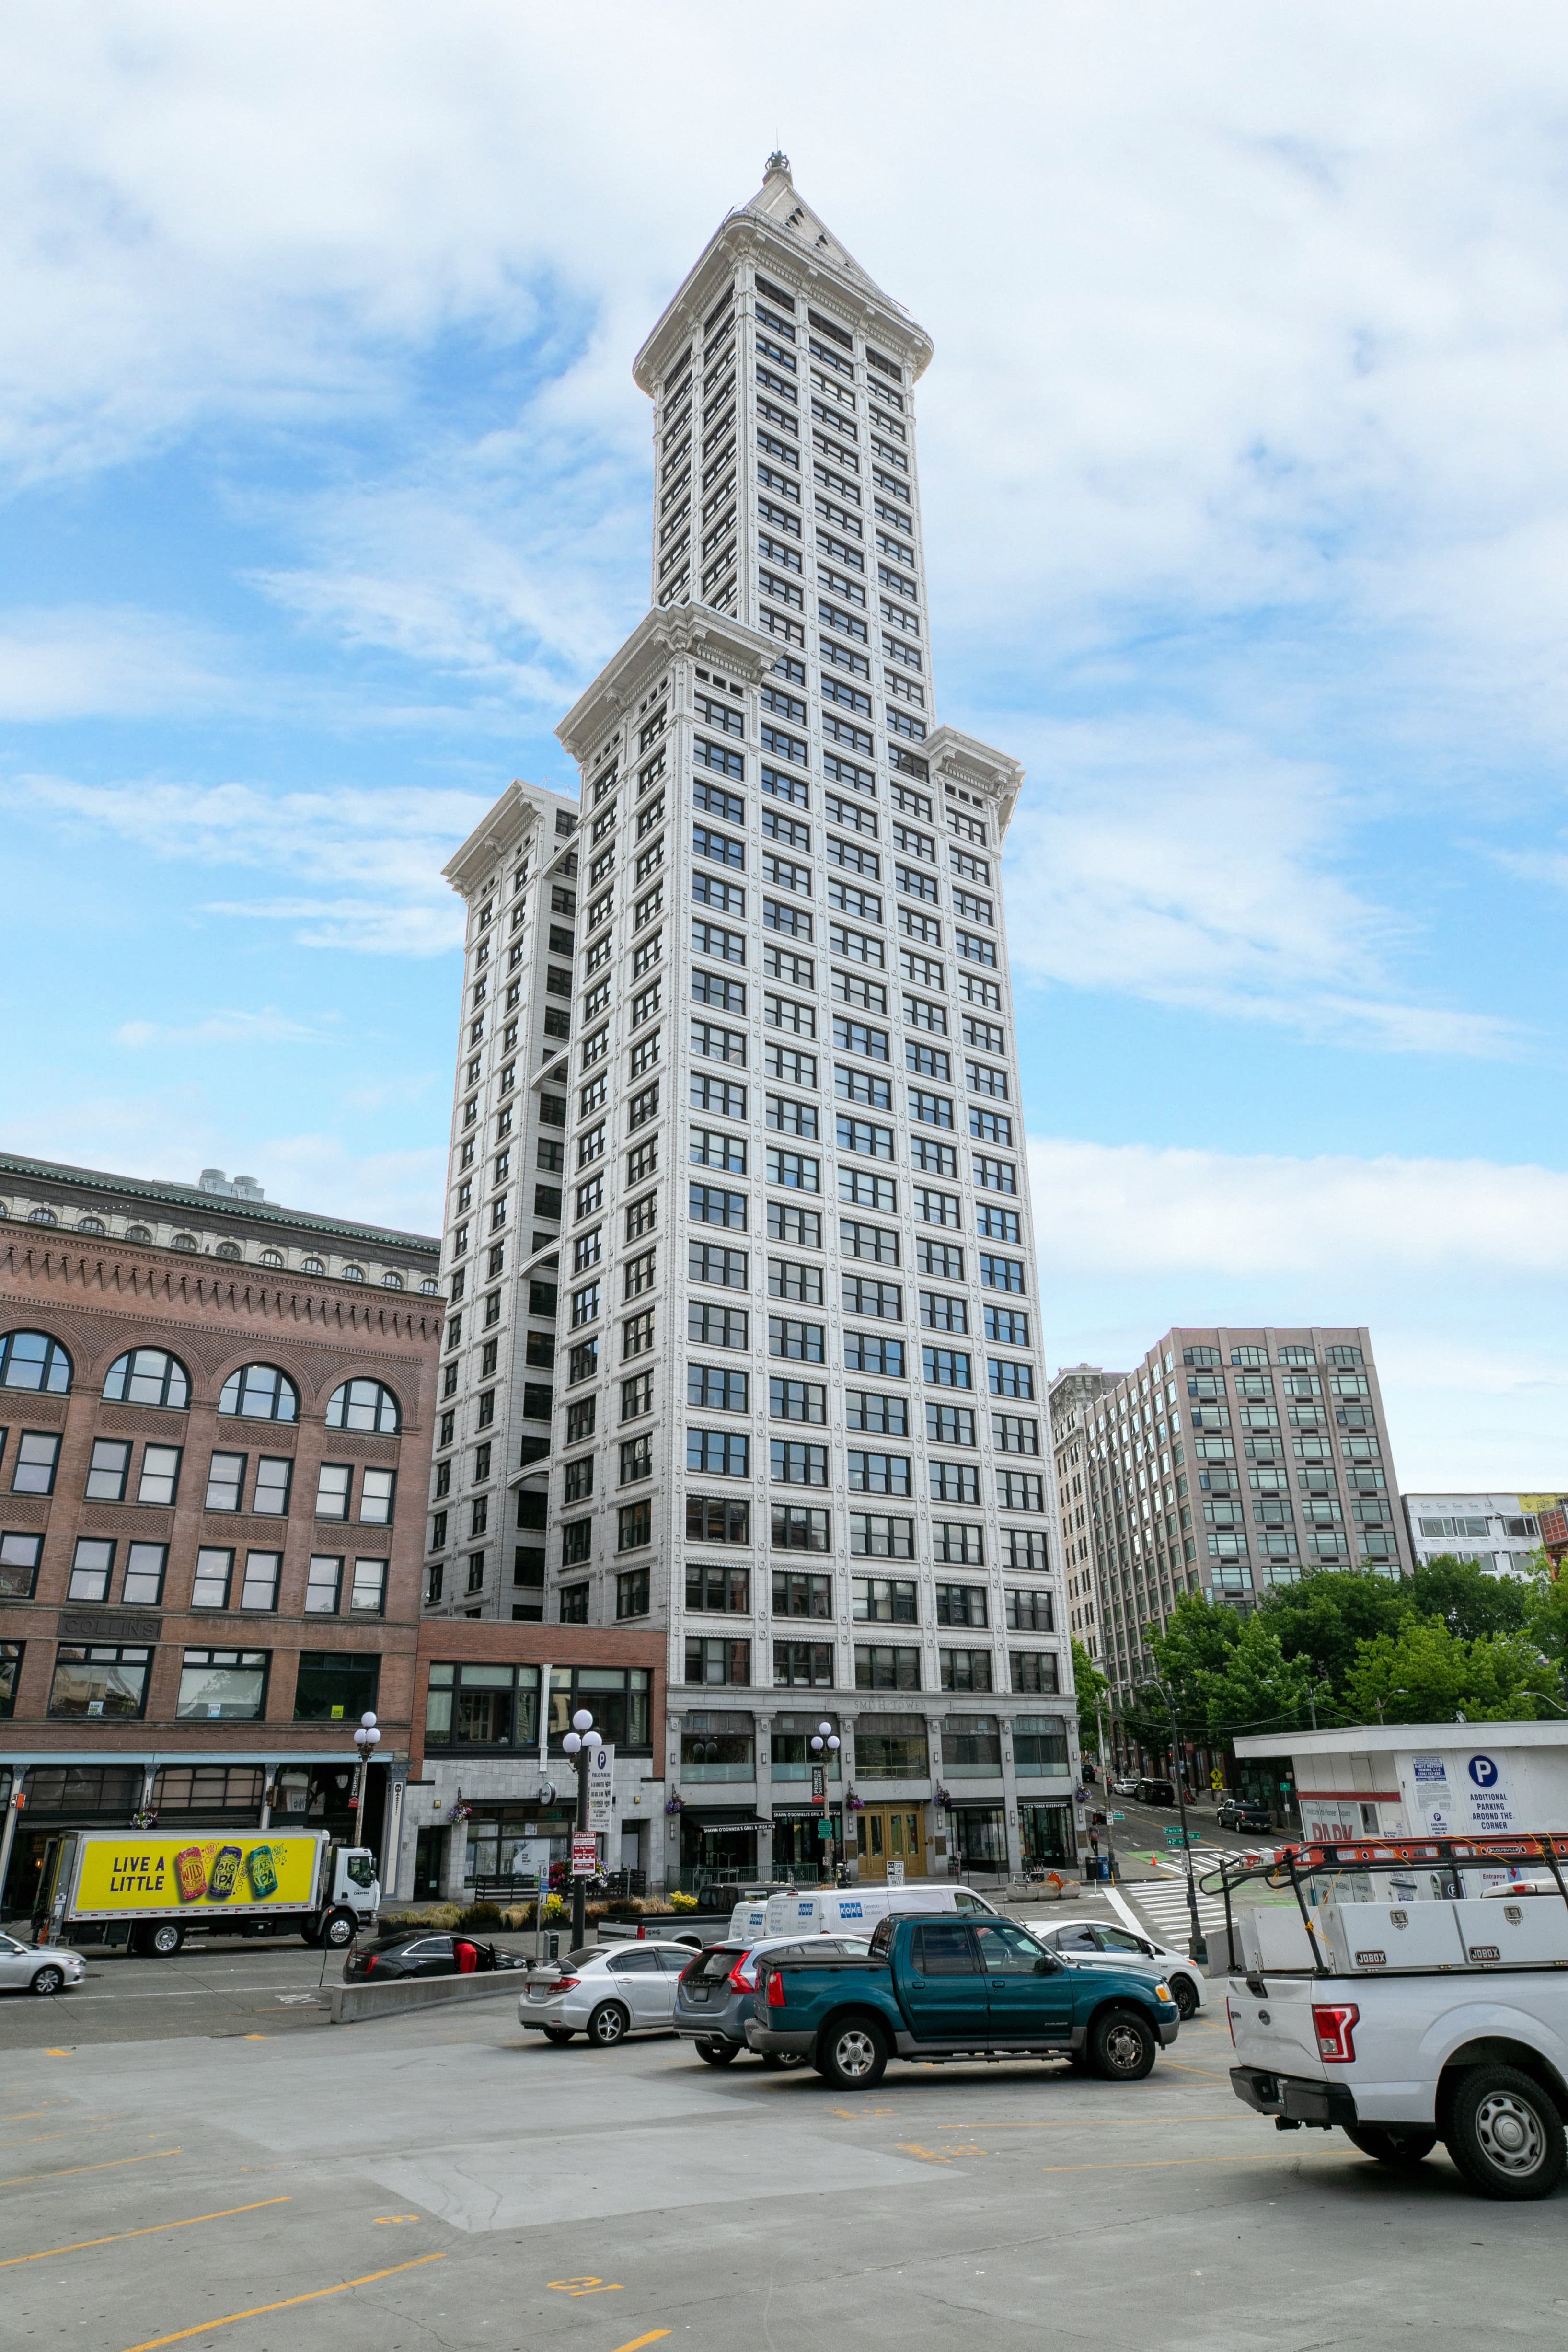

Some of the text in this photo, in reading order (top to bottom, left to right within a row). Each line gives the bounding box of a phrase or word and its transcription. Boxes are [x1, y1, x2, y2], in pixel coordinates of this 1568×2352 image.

[65, 1620, 155, 1637] COLLINS
[854, 1700, 926, 1710] SMITH TOWER
[113, 1856, 165, 1872] LIVE A
[218, 1863, 235, 1871] BIG
[254, 1861, 271, 1873] HAZY
[182, 1864, 203, 1881] WILD
[254, 1869, 274, 1884] IPA
[110, 1876, 165, 1891] LITTLE
[215, 1874, 233, 1886] IPA
[1358, 1953, 1385, 1963] JOBOX
[1472, 1948, 1499, 1958] JOBOX
